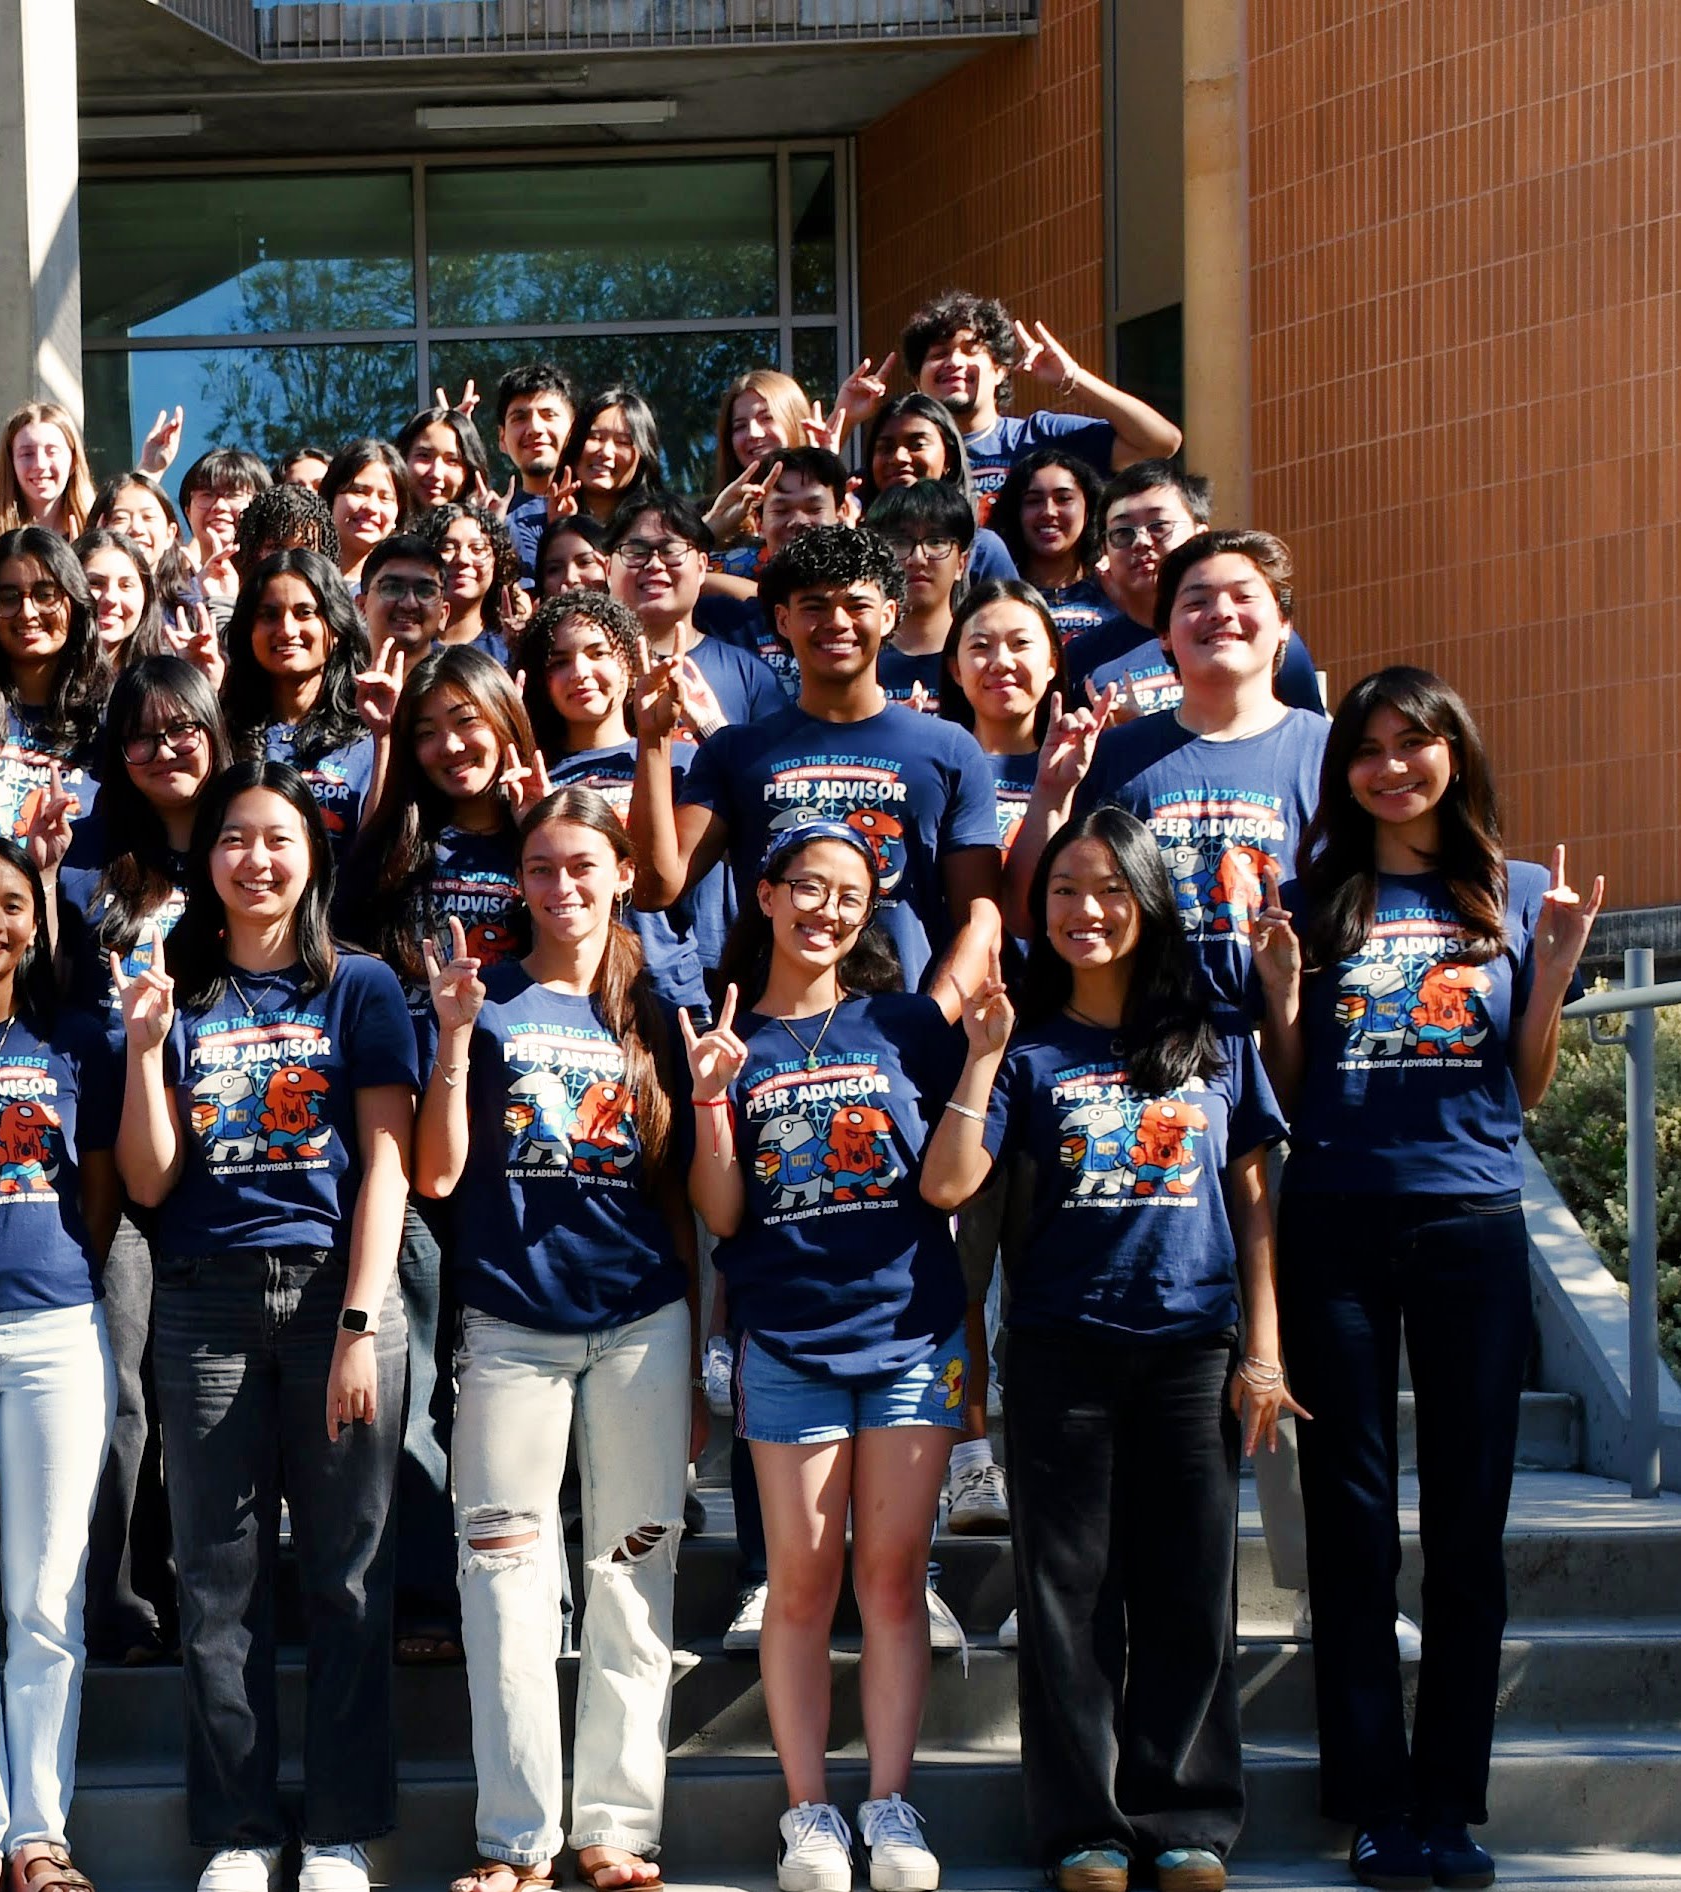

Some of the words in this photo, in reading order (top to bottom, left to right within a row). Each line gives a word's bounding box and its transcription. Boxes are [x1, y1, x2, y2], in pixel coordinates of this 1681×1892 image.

[771, 759, 800, 773] INTO
[804, 755, 826, 766] THE
[830, 755, 902, 772] ZOT-VERSE
[799, 769, 832, 778] FRIENDLY
[764, 781, 810, 801] PEER
[817, 781, 907, 801] ADVISOR
[1153, 791, 1183, 807] INTO
[1145, 818, 1192, 837] PEER
[1195, 818, 1285, 841] ADVISOR
[1377, 908, 1402, 922] THE
[1376, 1002, 1398, 1015] UCI
[197, 1021, 228, 1037] INTO
[231, 1016, 254, 1028] THE
[256, 1012, 326, 1027] ZOT-VERSE
[508, 1023, 537, 1035] INTO
[540, 1024, 563, 1036] THE
[190, 1046, 236, 1066] PEER
[242, 1037, 331, 1063] ADVISOR
[504, 1042, 554, 1063] PEER
[745, 1067, 773, 1088] INTO
[776, 1059, 800, 1073] THE
[803, 1053, 878, 1070] OT-VERSE
[1337, 1060, 1356, 1070] PEER
[1358, 1060, 1400, 1069] ACADEMIC
[1402, 1058, 1443, 1067] ADVISORS
[1055, 1067, 1087, 1082] INTO
[1089, 1064, 1115, 1073] THE
[746, 1089, 790, 1119] PEER
[799, 1075, 890, 1103] ADVISOR
[1051, 1086, 1102, 1105] PEER
[228, 1109, 247, 1122] UCI
[1097, 1142, 1118, 1154] UCI
[213, 1164, 253, 1175] ACADEMIC
[255, 1162, 292, 1172] ADVISORS
[791, 1154, 811, 1167] UCI
[506, 1169, 524, 1178] PEER
[526, 1169, 566, 1178] ACADEMIC
[1076, 1198, 1119, 1207] ACADEMIC
[782, 1208, 820, 1221] ACADEMIC
[823, 1202, 862, 1215] ADVISORS
